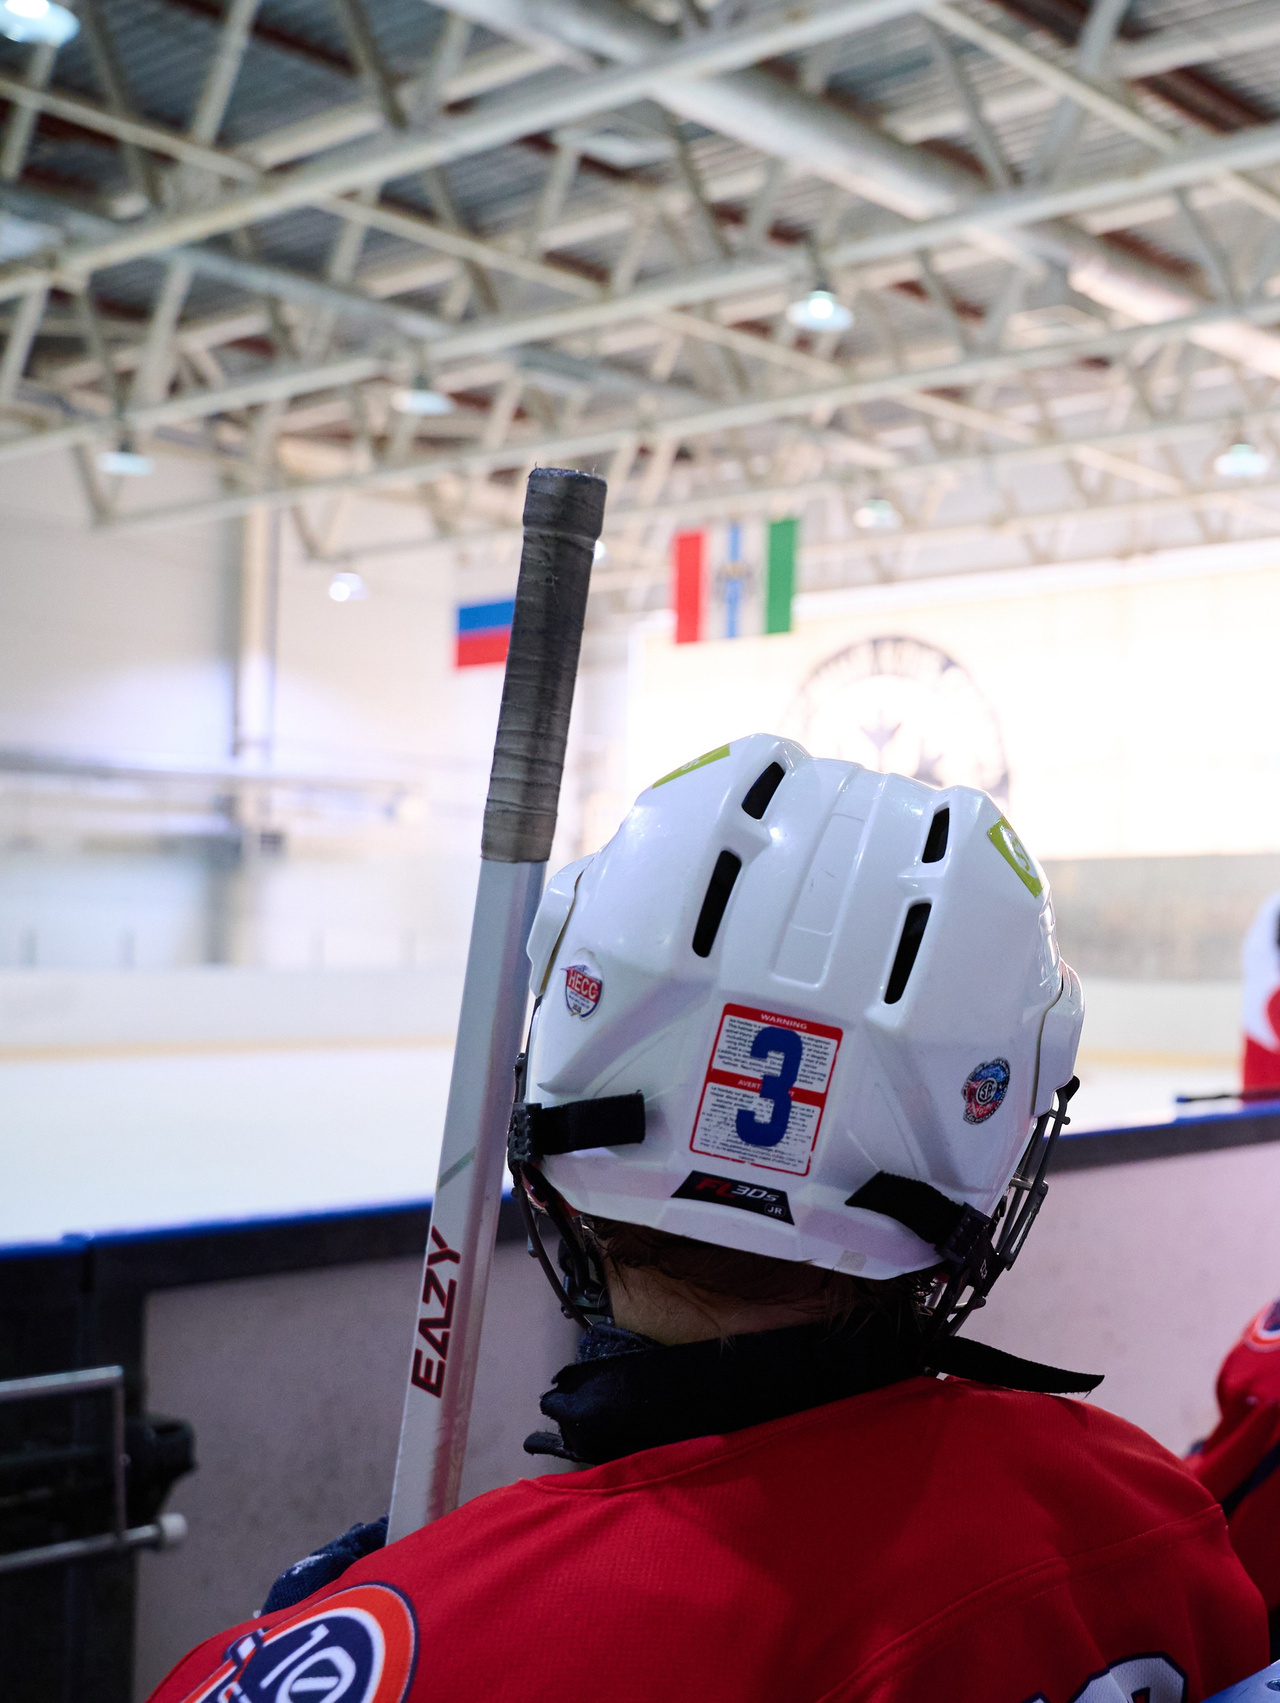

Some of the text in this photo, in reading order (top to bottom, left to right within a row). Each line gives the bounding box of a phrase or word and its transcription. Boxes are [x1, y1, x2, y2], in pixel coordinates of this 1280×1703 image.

[760, 1013, 807, 1030] WARNING
[736, 1026, 803, 1147] 3
[767, 1206, 783, 1215] JR
[411, 1225, 461, 1398] EAZY
